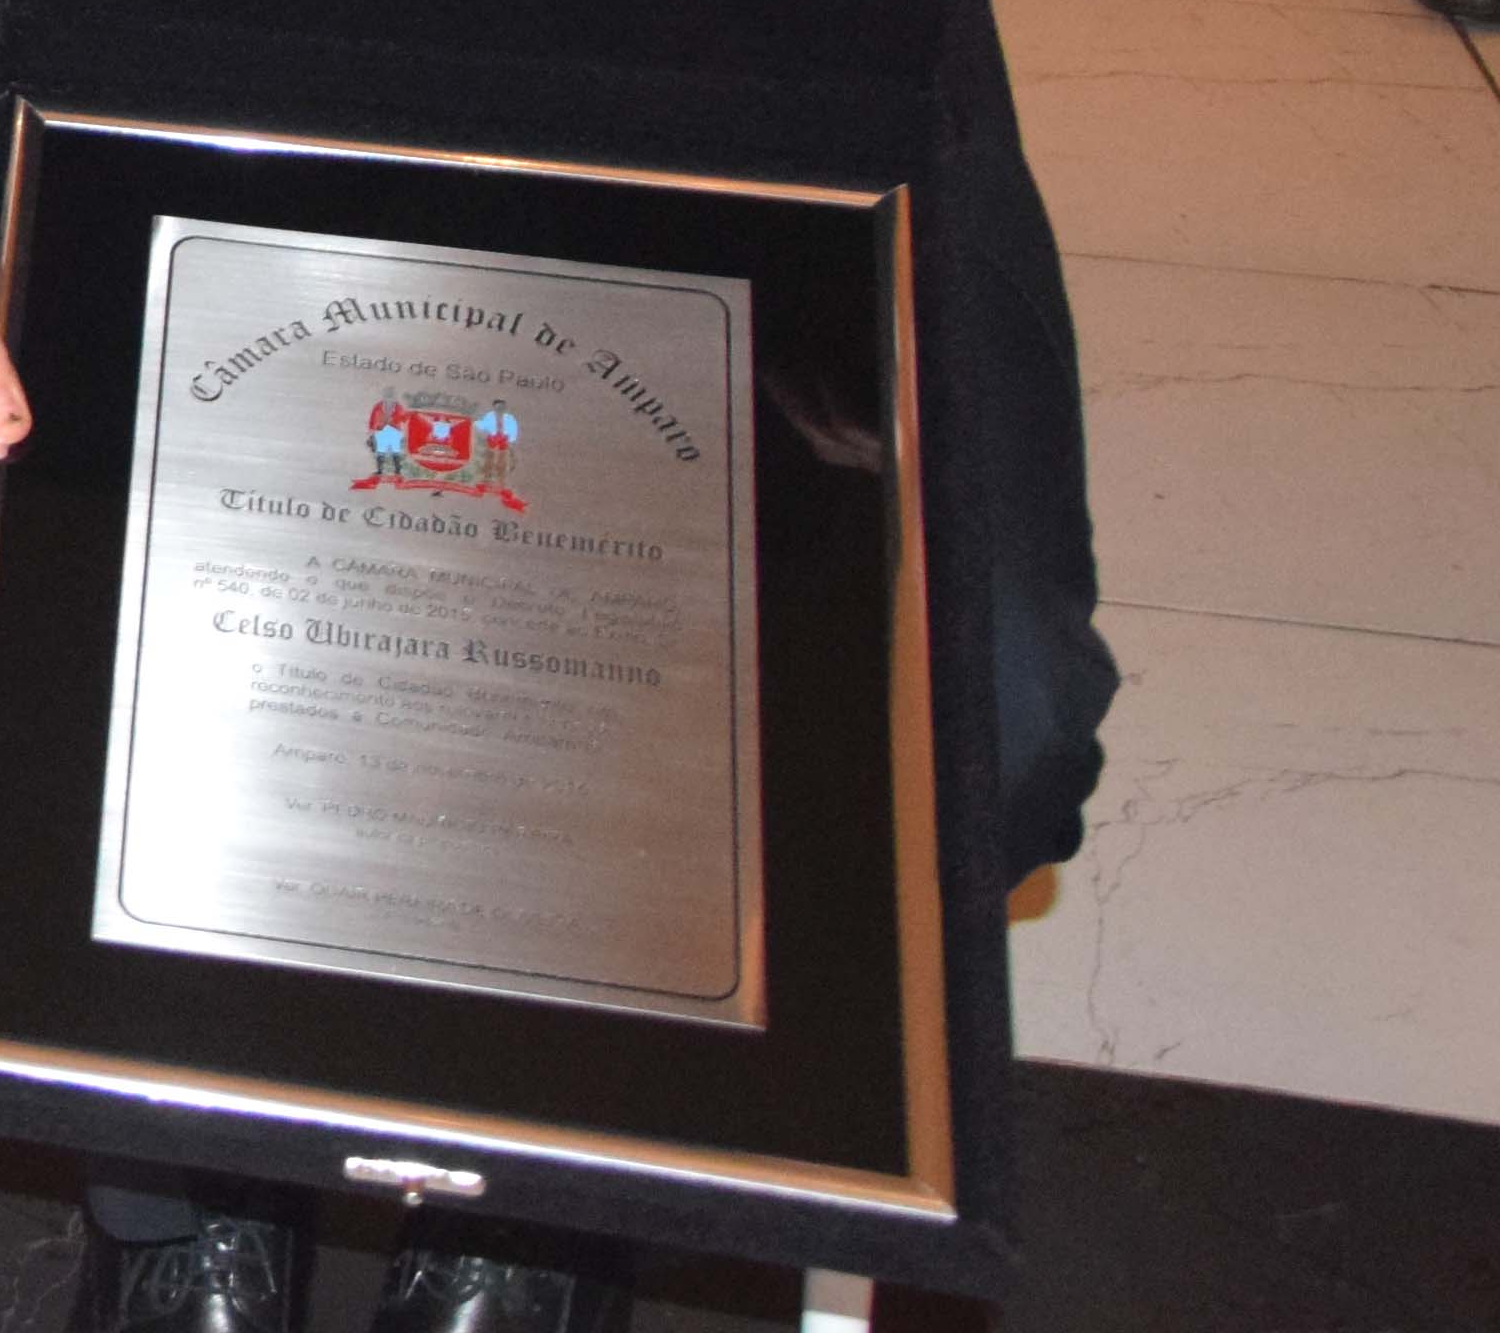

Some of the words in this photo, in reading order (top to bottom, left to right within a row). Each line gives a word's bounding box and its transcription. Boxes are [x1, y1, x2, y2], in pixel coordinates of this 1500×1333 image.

[188, 318, 314, 404] Câmara
[321, 294, 525, 337] Municipal
[533, 320, 577, 357] de
[581, 346, 703, 464] Amparo
[321, 349, 403, 375] Estado
[408, 359, 437, 378] de
[444, 361, 491, 384] São
[498, 368, 566, 394] Paulo
[218, 487, 312, 520] Título
[320, 500, 350, 524] de
[362, 505, 479, 539] Cidadão
[491, 518, 664, 563] Benemérito
[259, 584, 283, 600] de
[287, 587, 312, 603] 02
[316, 591, 339, 606] de
[211, 608, 295, 641] Celso
[304, 617, 451, 662] Ubirajara
[460, 637, 664, 689] Russomanno
